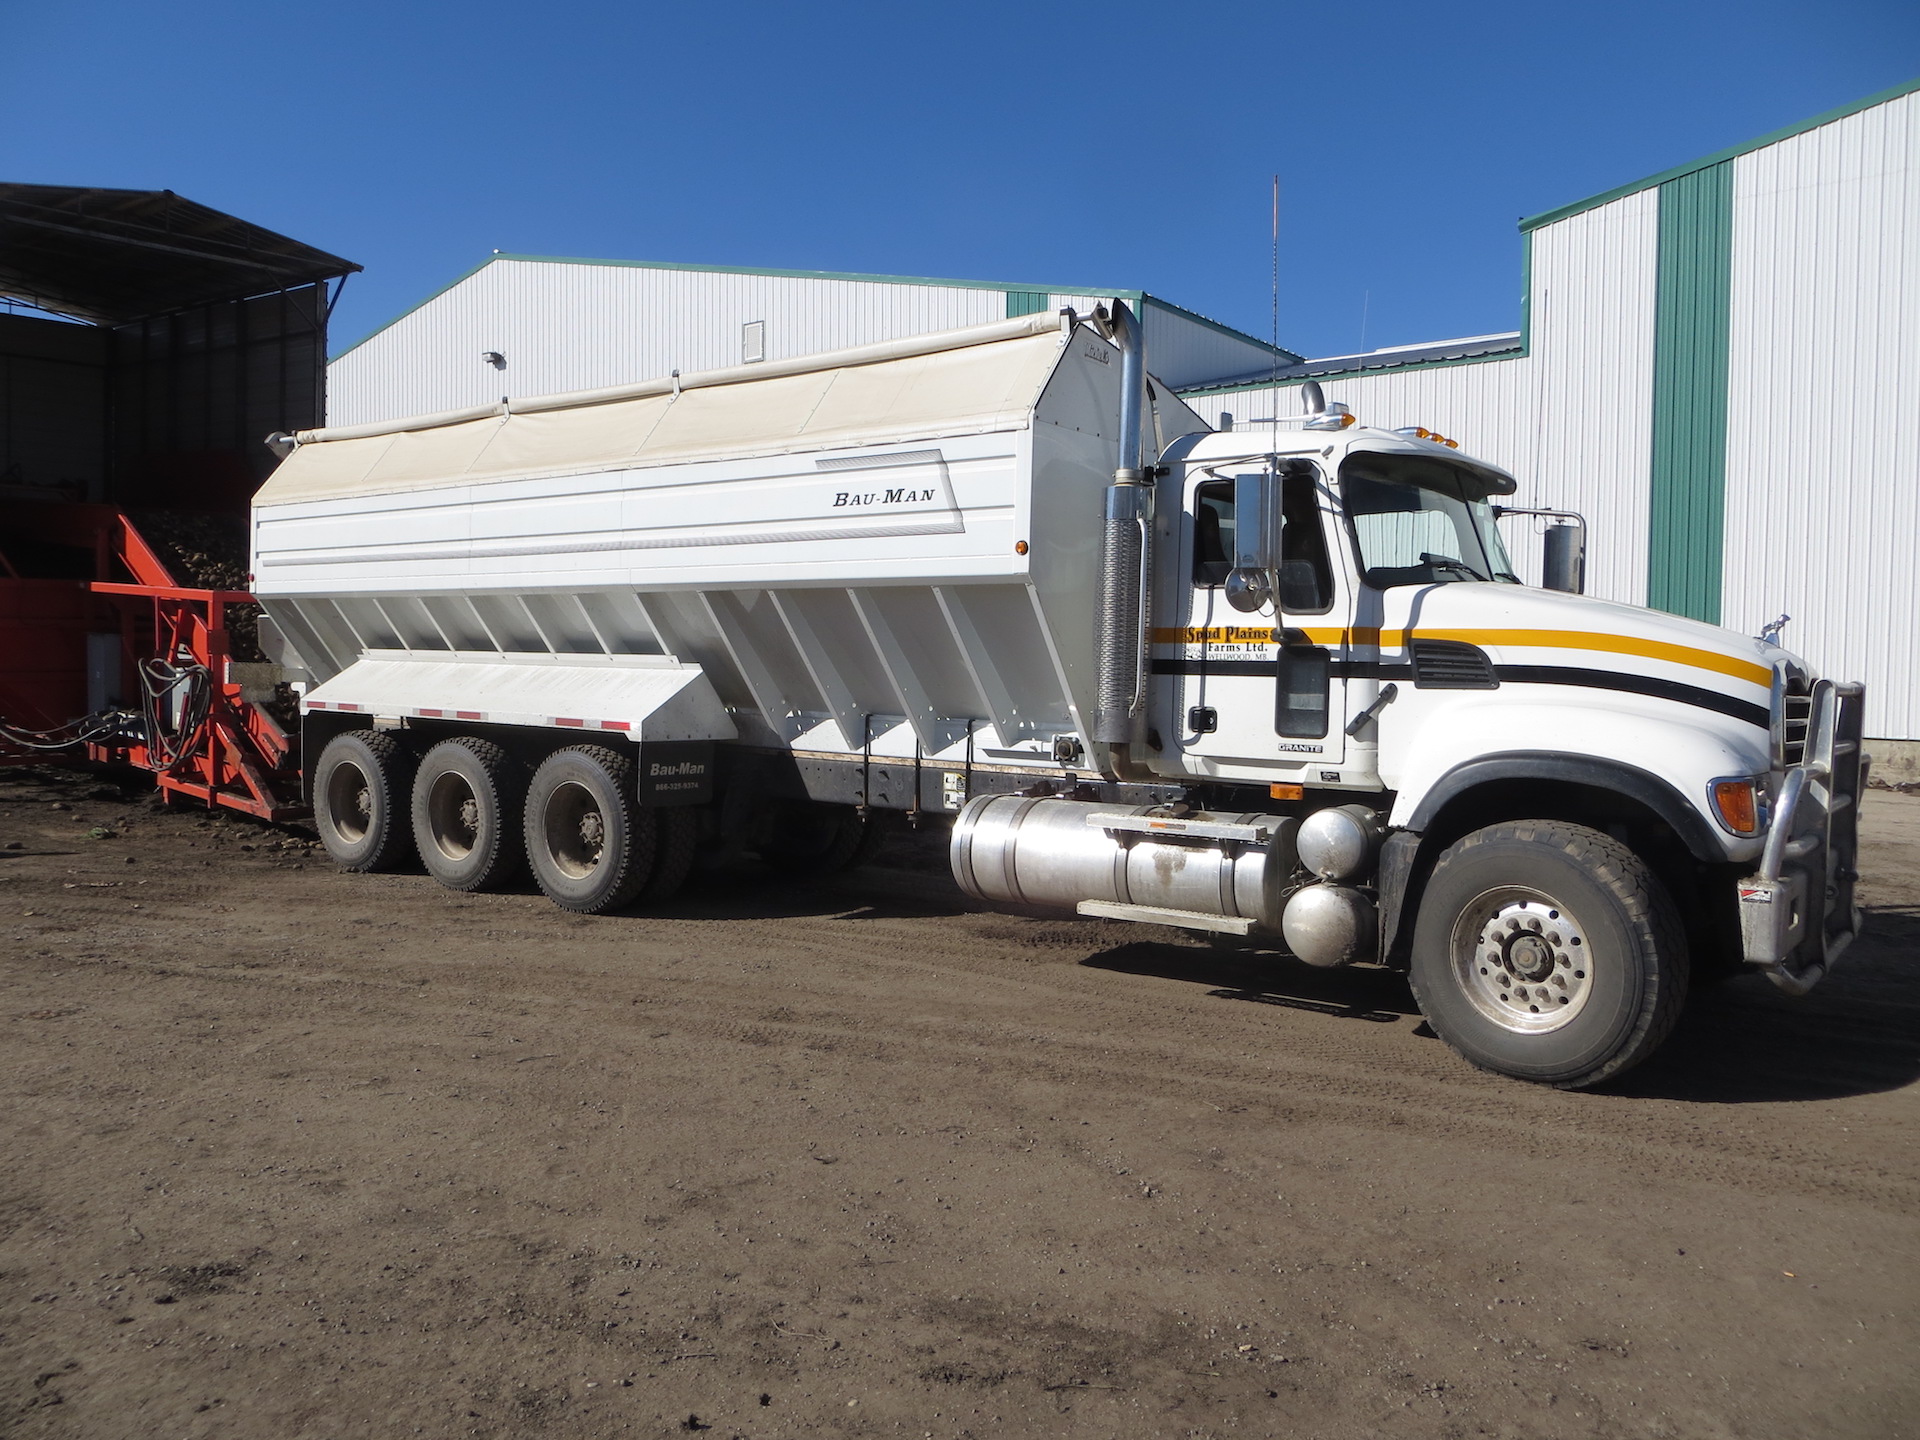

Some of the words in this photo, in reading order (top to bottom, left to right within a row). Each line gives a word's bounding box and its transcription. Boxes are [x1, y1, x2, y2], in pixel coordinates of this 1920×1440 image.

[1185, 627, 1220, 643] Spud
[1225, 627, 1269, 643] Plains
[1208, 642, 1240, 652] Farms
[1246, 642, 1268, 652] Ltd.
[1278, 743, 1322, 753] GRANITE
[650, 762, 705, 776] Bau-Man
